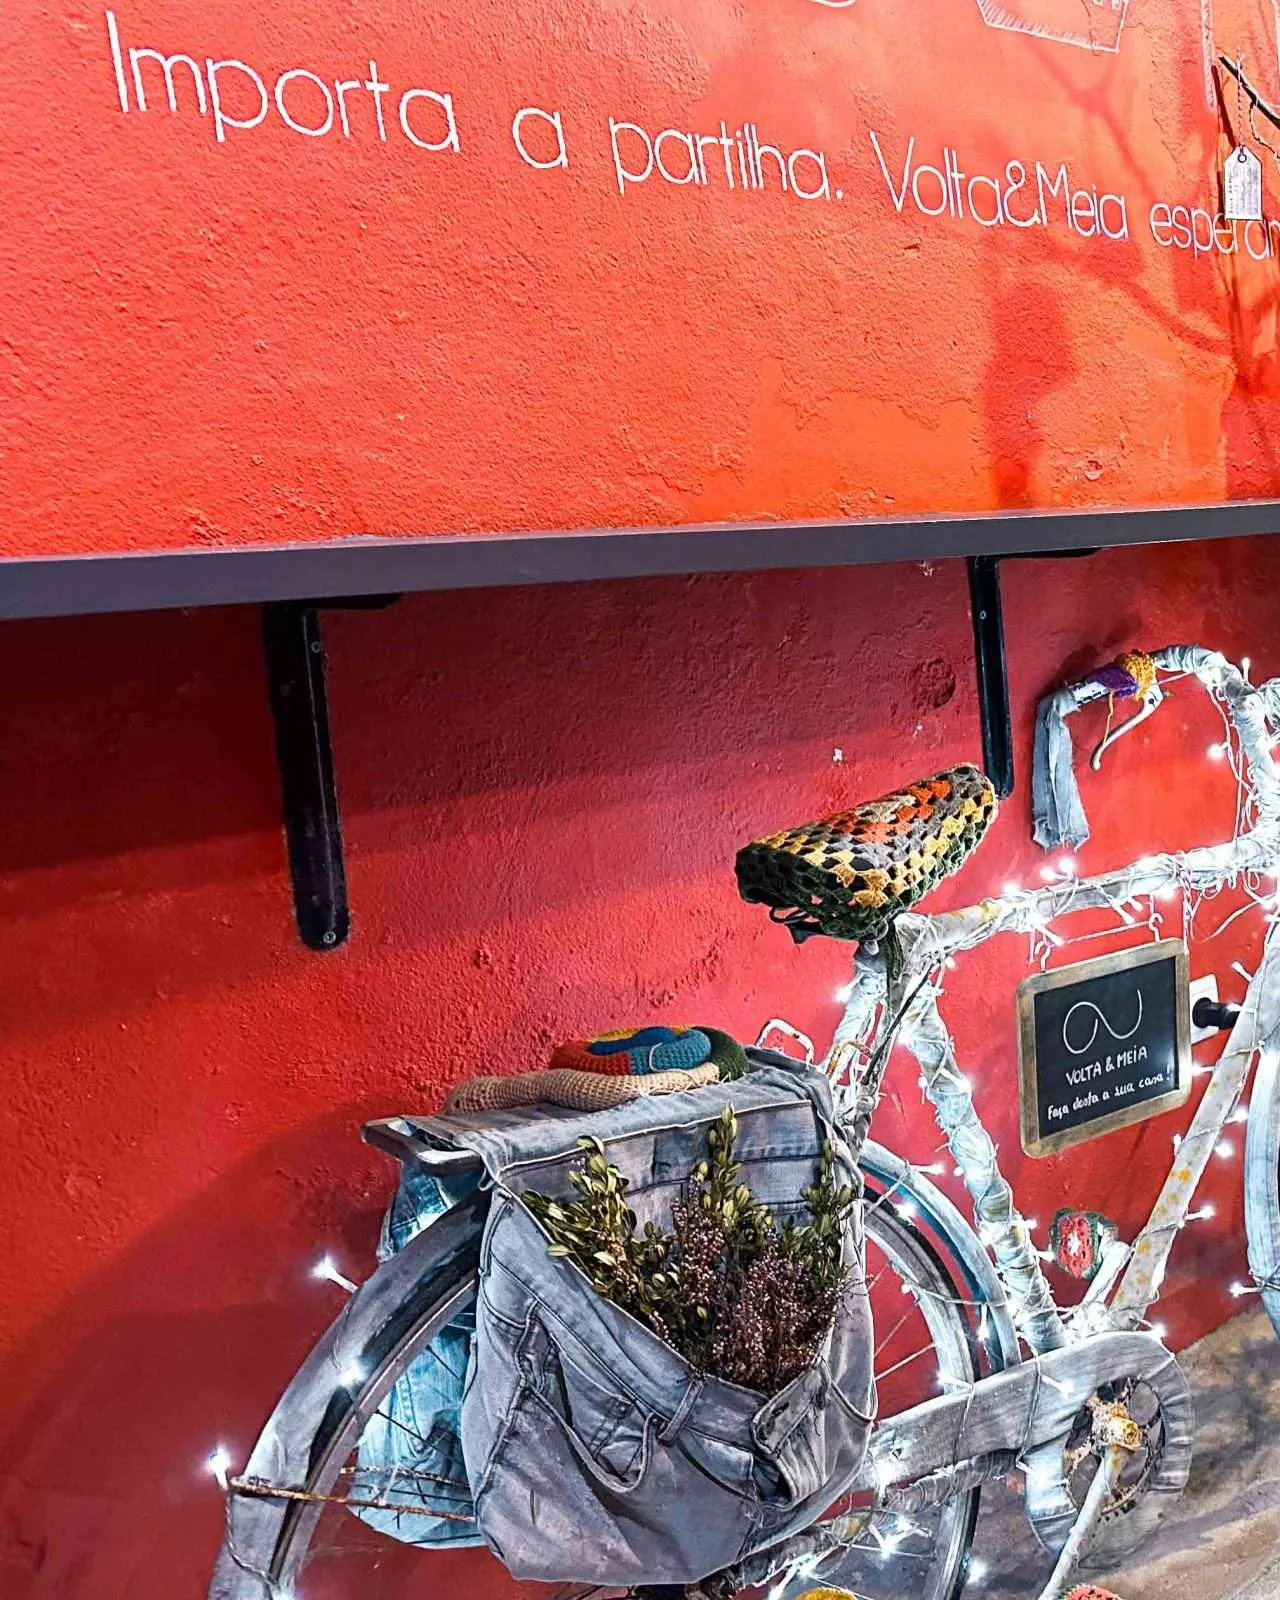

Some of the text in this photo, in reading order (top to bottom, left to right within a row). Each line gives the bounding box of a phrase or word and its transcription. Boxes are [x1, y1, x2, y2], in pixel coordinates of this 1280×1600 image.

[105, 10, 460, 153] Importa
[512, 106, 567, 169] a
[609, 116, 845, 201] partilha.
[869, 130, 1129, 239] Volta&Meia
[1065, 1060, 1101, 1086] VOLTA
[1105, 1056, 1115, 1073] &
[1102, 1090, 1110, 1101] a
[1114, 1083, 1135, 1096] sua
